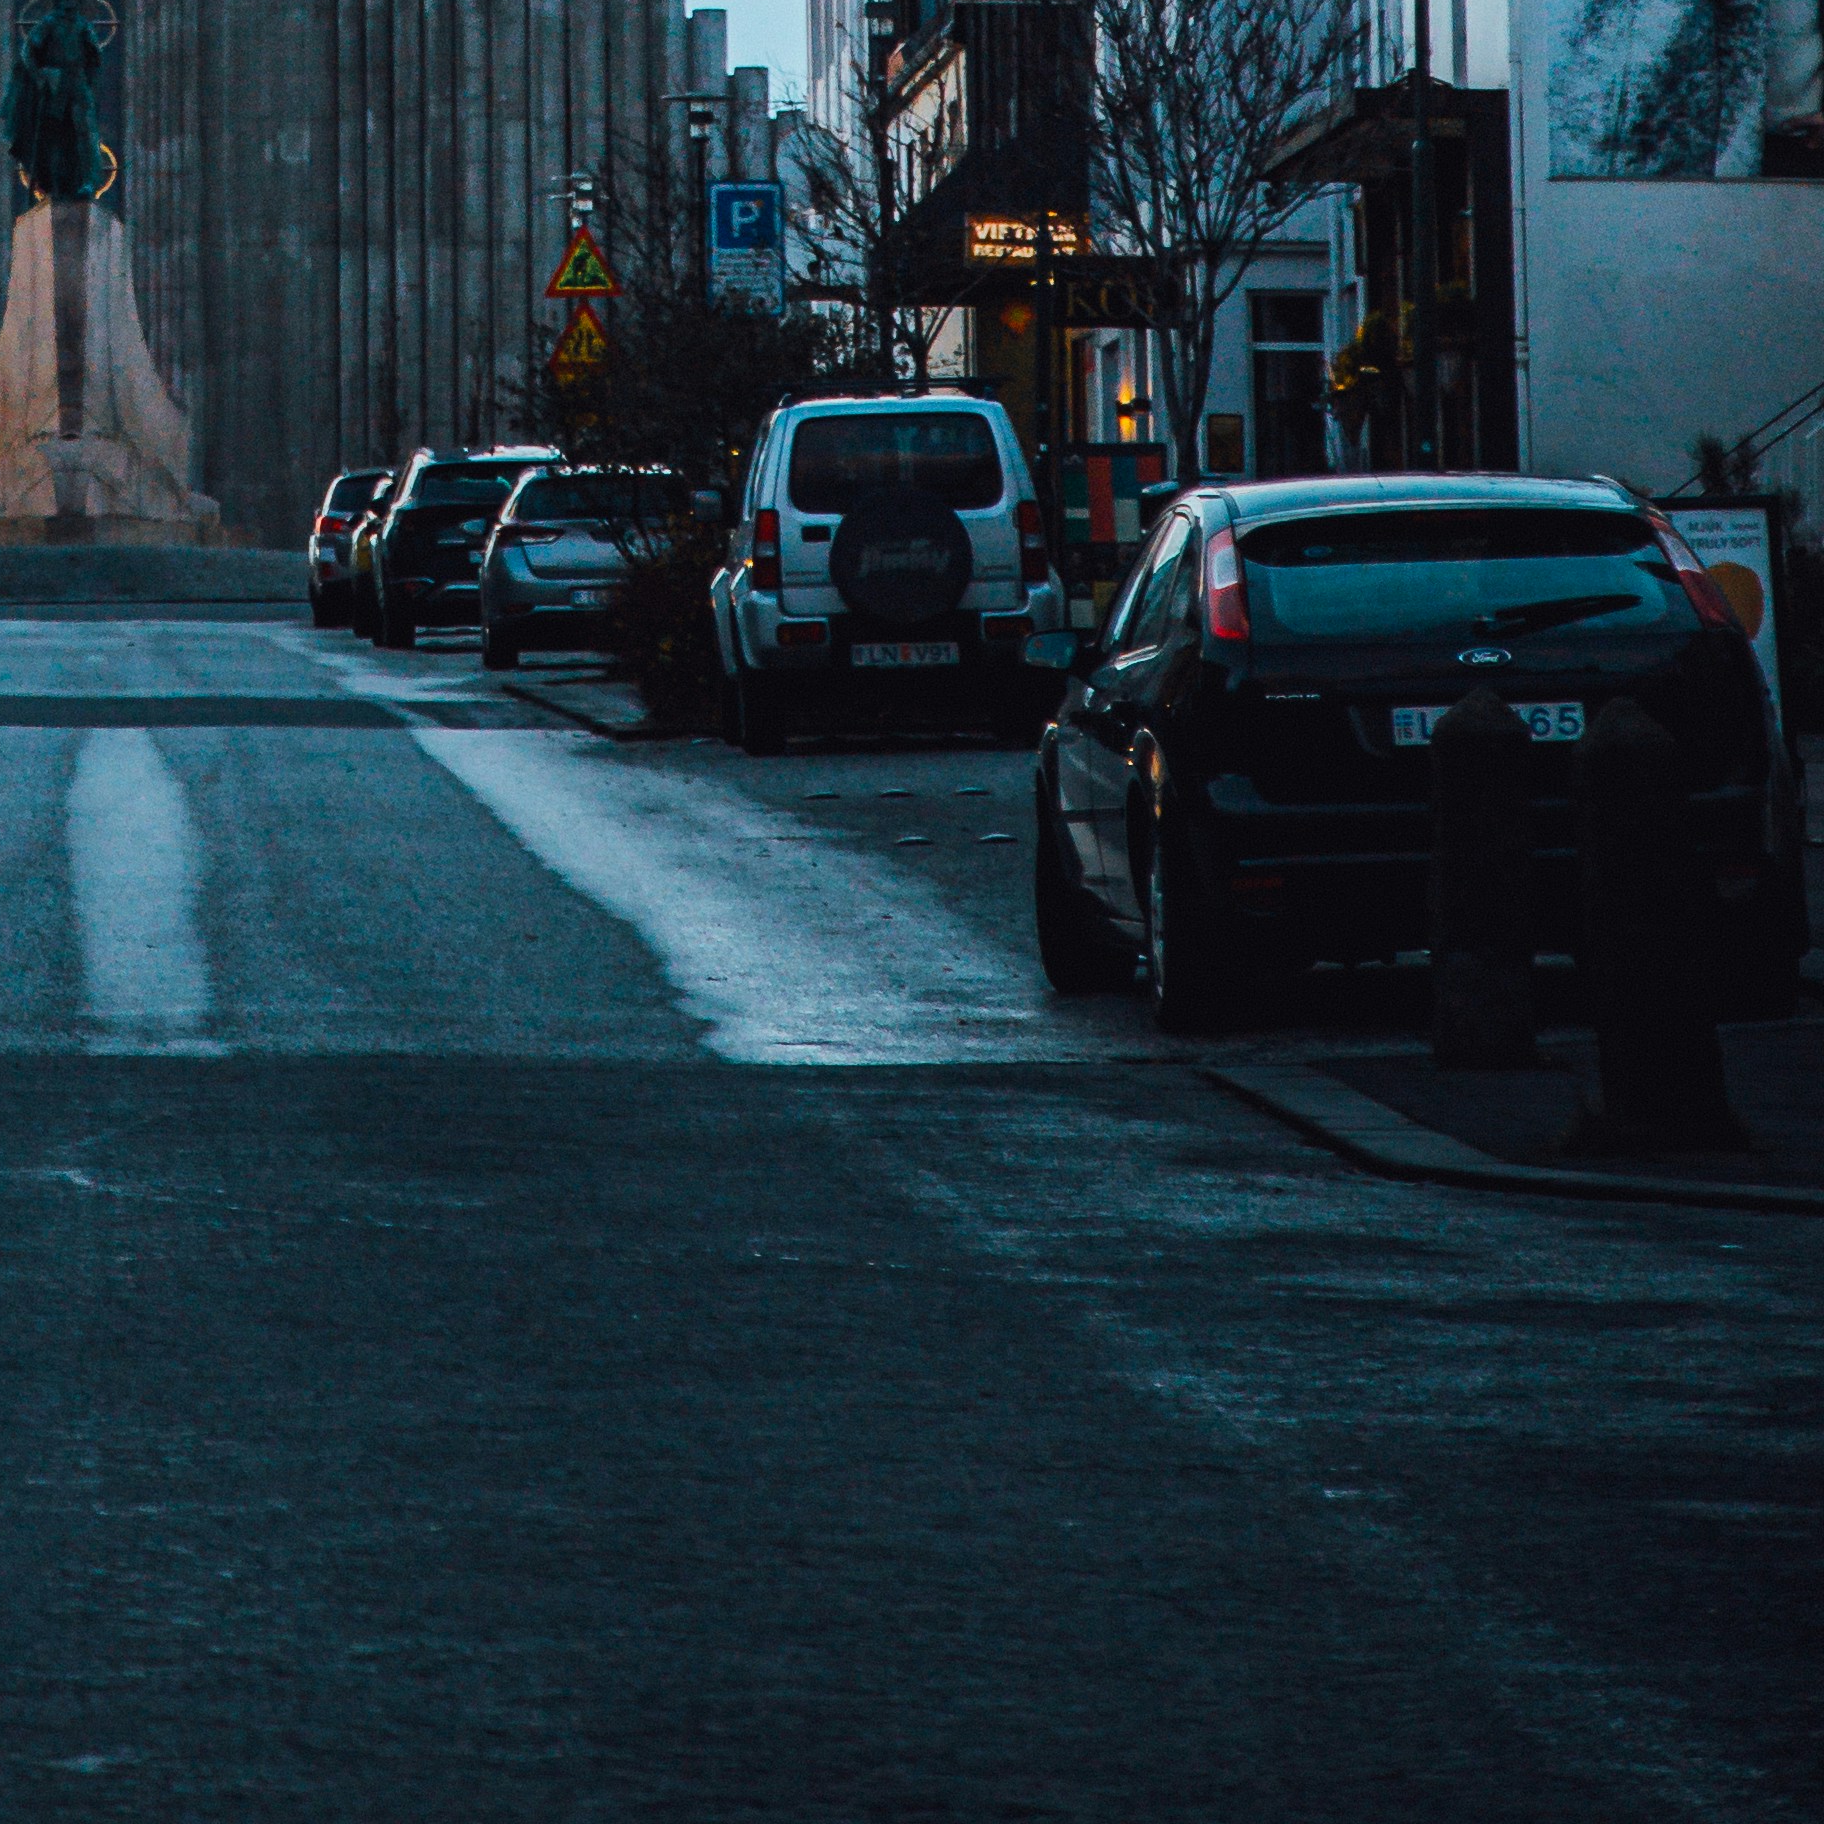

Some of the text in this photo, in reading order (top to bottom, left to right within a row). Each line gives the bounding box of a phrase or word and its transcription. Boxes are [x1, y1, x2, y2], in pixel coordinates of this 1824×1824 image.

[732, 200, 760, 237] P
[973, 244, 1075, 257] RESTAUT
[1530, 706, 1580, 736] 65
